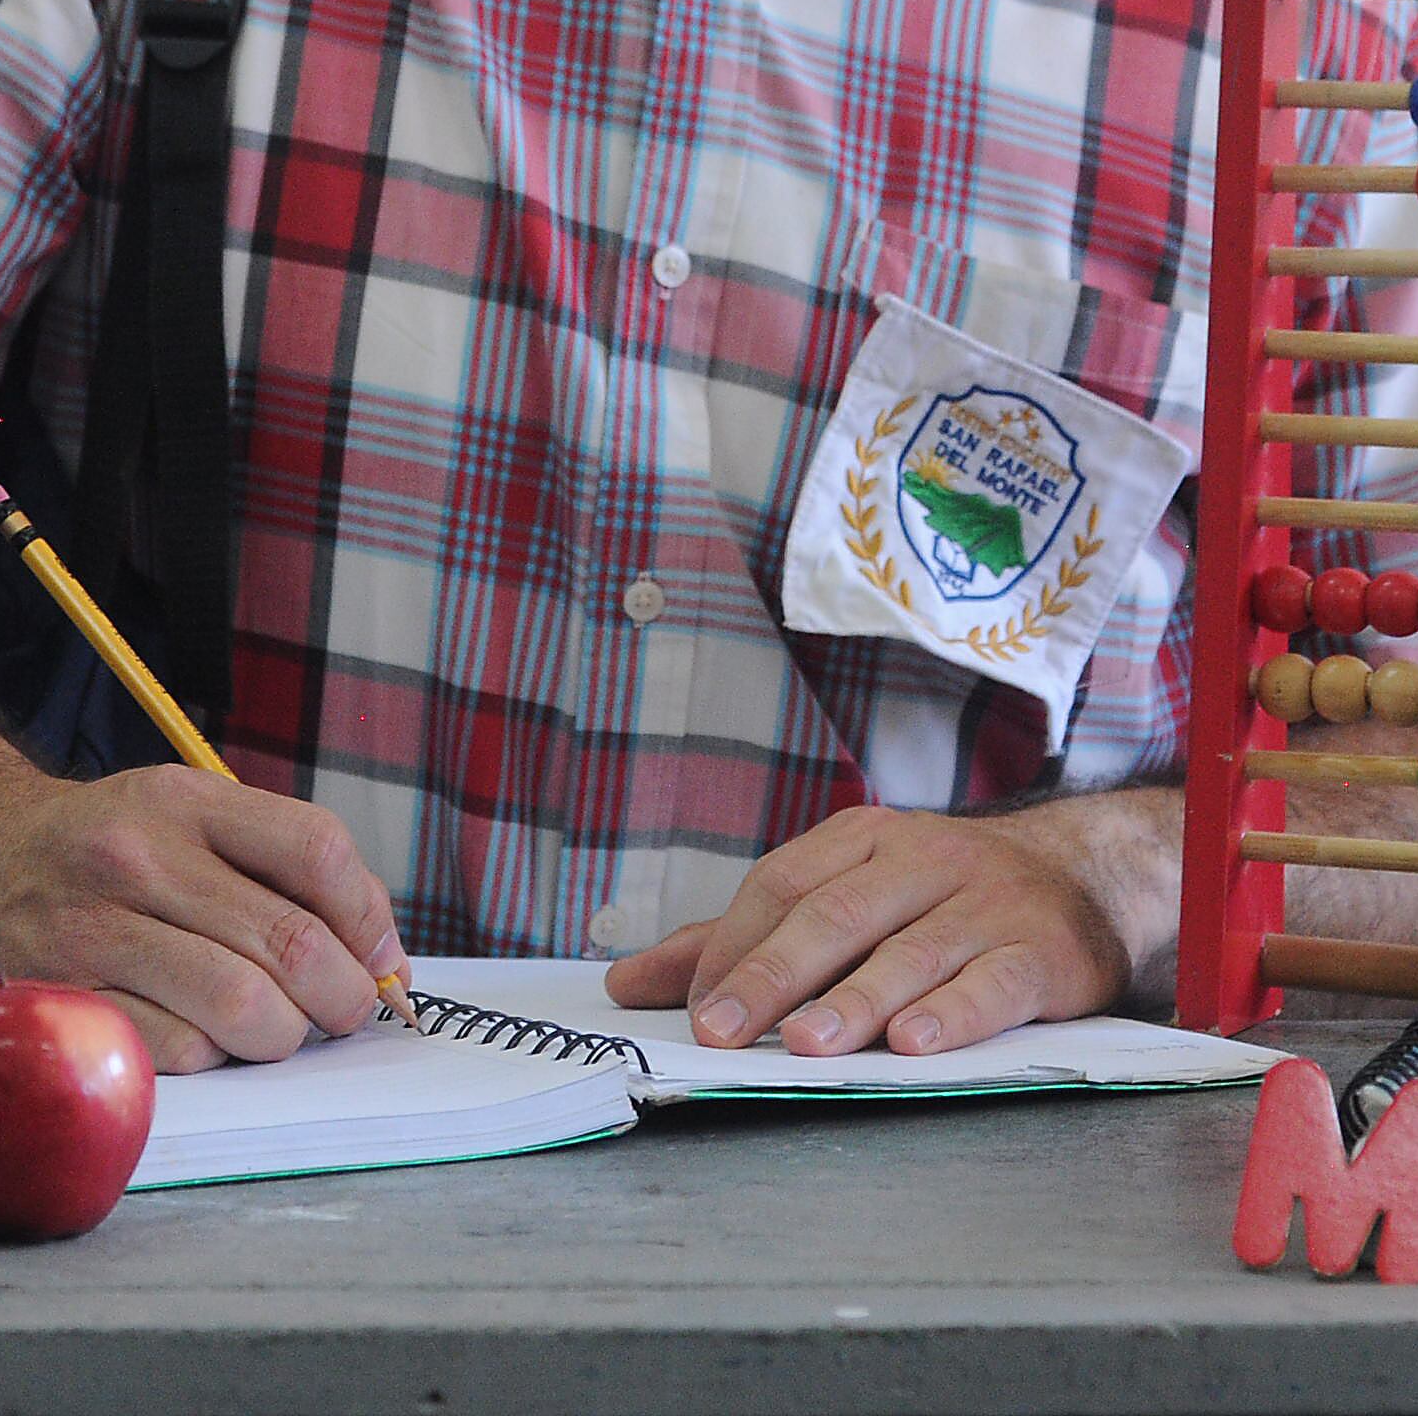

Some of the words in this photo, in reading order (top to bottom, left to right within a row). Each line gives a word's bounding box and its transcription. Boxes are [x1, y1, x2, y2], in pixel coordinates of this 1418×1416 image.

[934, 441, 969, 474] DEL
[976, 467, 1048, 516] MONTE
[939, 419, 980, 452] SAN
[986, 447, 1060, 502] RAFAEL
